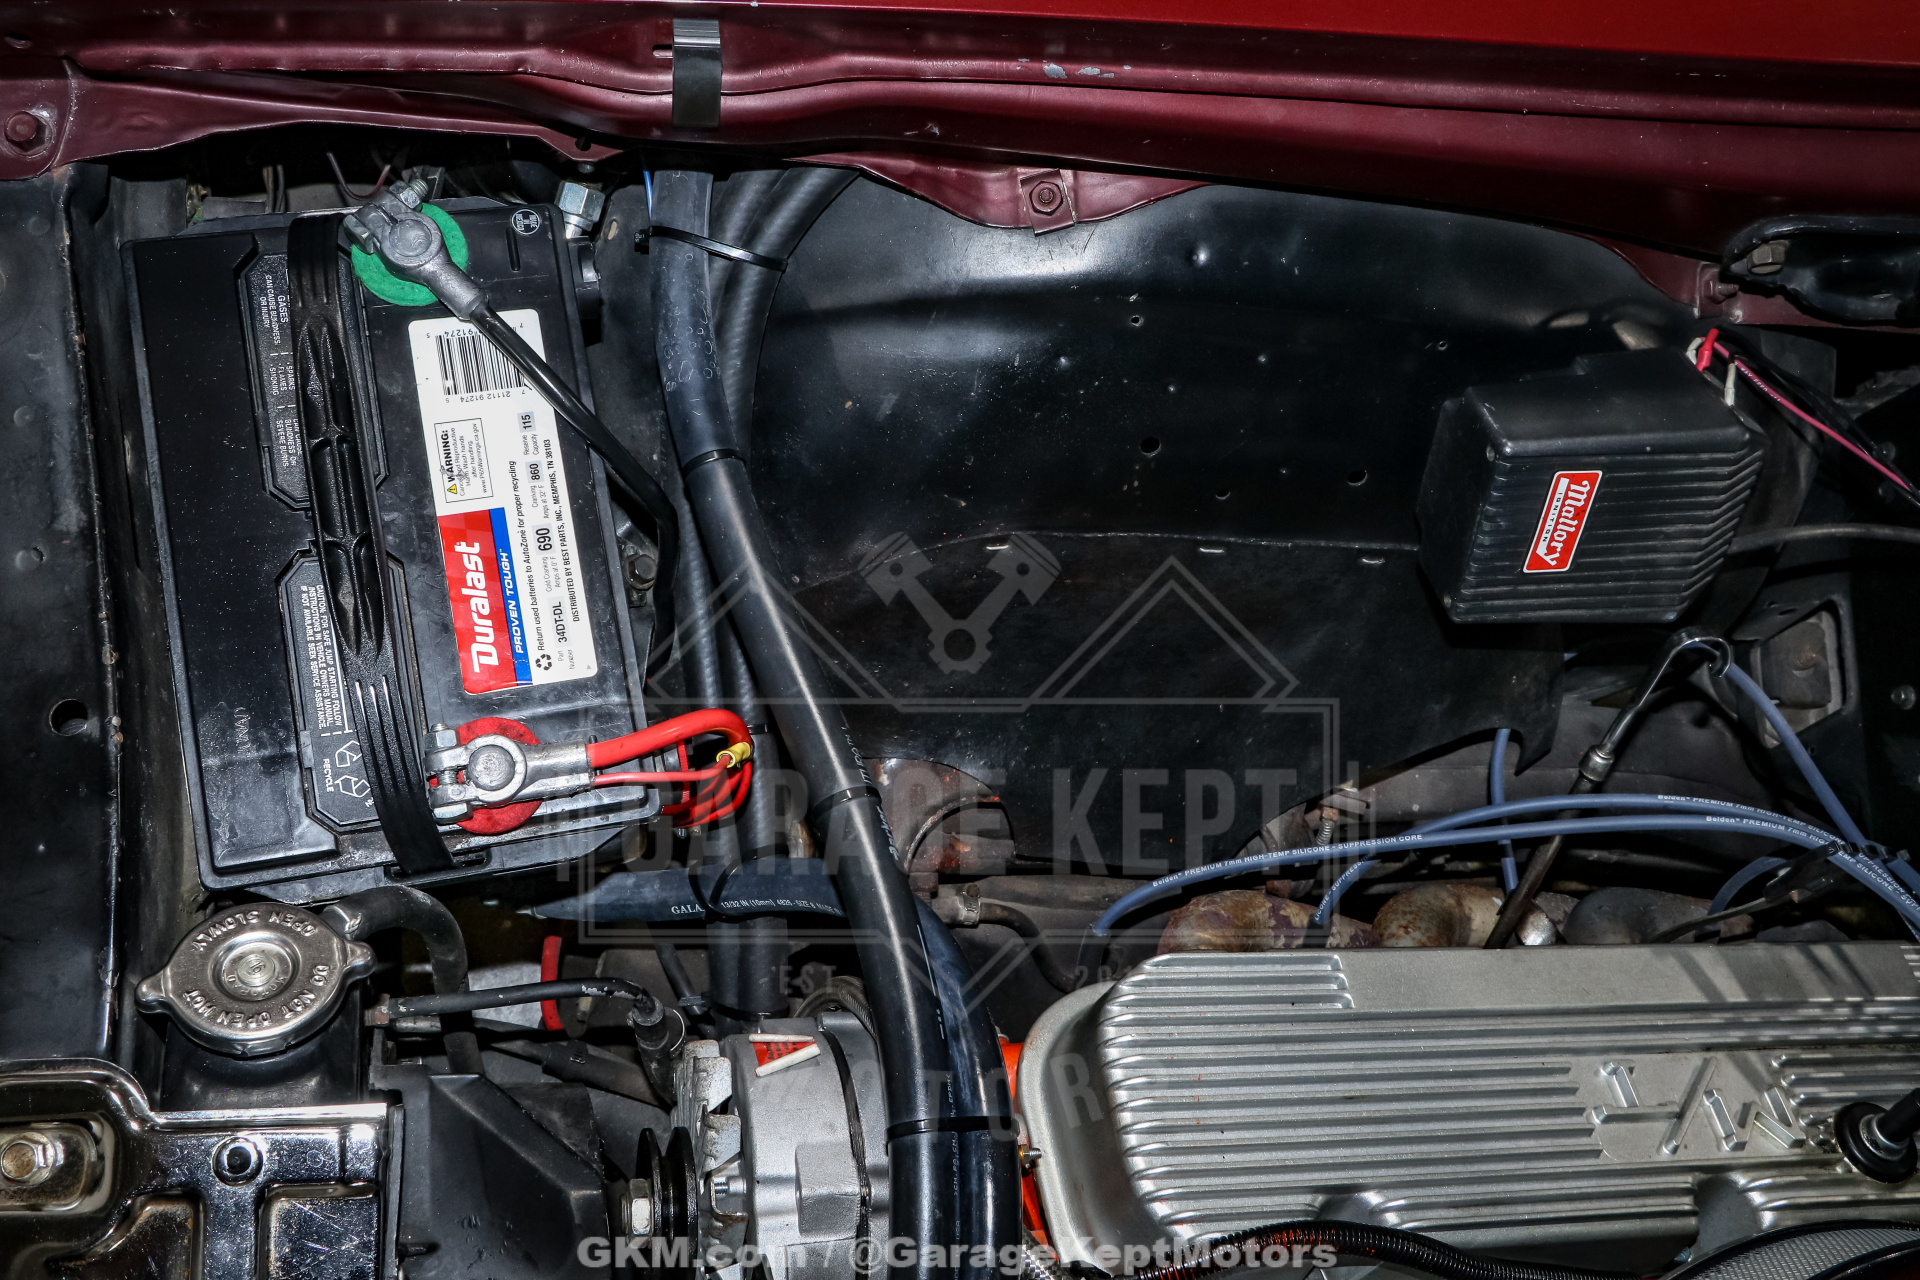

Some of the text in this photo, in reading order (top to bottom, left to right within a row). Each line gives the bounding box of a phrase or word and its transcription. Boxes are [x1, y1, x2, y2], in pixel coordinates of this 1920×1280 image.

[264, 274, 273, 288] CAN
[259, 295, 270, 328] OR INJURY
[266, 288, 276, 310] CAUSE
[277, 294, 288, 323] GASES
[269, 366, 279, 396] SMOKING
[277, 365, 287, 391] FLAMES
[285, 364, 295, 390] SPARKS
[459, 393, 484, 402] 91274
[486, 390, 510, 399] 21112
[521, 413, 532, 430] 115
[275, 419, 289, 467] SEVERE BURNS
[284, 418, 295, 453] BLINDNESS
[451, 428, 462, 463] Reproductive
[522, 433, 530, 455] Reserve
[531, 432, 540, 455] Capacity
[543, 438, 553, 459] 38103
[440, 430, 455, 483] WARNING:
[461, 452, 469, 470] Wash
[546, 459, 555, 470] TN
[508, 459, 519, 492] recycling
[529, 462, 541, 480] 860
[530, 484, 539, 508] Cranking
[549, 470, 560, 505] MEMPHIS,
[514, 492, 525, 517] proper
[1543, 491, 1562, 542] IGNITION
[517, 517, 525, 528] for
[557, 521, 567, 547] PARTS,
[1546, 480, 1591, 566] Mallory
[535, 526, 553, 551] 690
[525, 564, 533, 573] to
[561, 548, 571, 566] BEST
[542, 555, 553, 592] Cold Cranking
[564, 566, 573, 577] BY
[299, 584, 308, 592] IF
[300, 592, 310, 606] NOT
[527, 573, 538, 606] batteries
[566, 577, 580, 622] DISTRIBUTED
[307, 586, 321, 632] INSTRUCTIONS
[454, 541, 500, 673] Duralast
[500, 551, 523, 653] PROVEN TOUGH
[302, 608, 314, 641] AVAILABLE
[319, 614, 329, 629] FOR
[532, 606, 541, 625] used
[552, 601, 567, 642] 34DT-DL
[314, 632, 322, 640] IN
[321, 629, 331, 646] SAFE
[536, 625, 545, 651] Return
[307, 642, 316, 659] SEEK
[315, 641, 326, 668] VEHICLE
[324, 648, 334, 665] JUMP
[557, 649, 565, 662] Part
[567, 648, 575, 670] Number
[309, 660, 321, 687] SERVICE
[319, 668, 330, 697] OWNERS
[326, 666, 338, 699] STARTING
[331, 699, 342, 726] FOLLOW
[322, 757, 334, 792] RECYCLE
[1693, 797, 1734, 808] PREMIUM
[1736, 803, 1755, 812] 7mm
[1757, 808, 1806, 827] HIGH-TEMP
[1184, 862, 1222, 877] PREMIUM
[1224, 858, 1243, 868] 7mm
[1244, 850, 1290, 862] HIGH-TEMP
[1292, 845, 1330, 855] SILICONE
[1338, 836, 1397, 850] SUPPRESSION
[1398, 834, 1423, 842] CORE
[1706, 815, 1736, 823] Belden
[1743, 818, 1786, 832] PREMIUM
[1787, 826, 1807, 837] 7mm
[1856, 861, 1895, 892] SILICONE
[190, 909, 317, 951] OPEN SLOWLY
[181, 964, 330, 1028] DO NOT OPEN HOT
